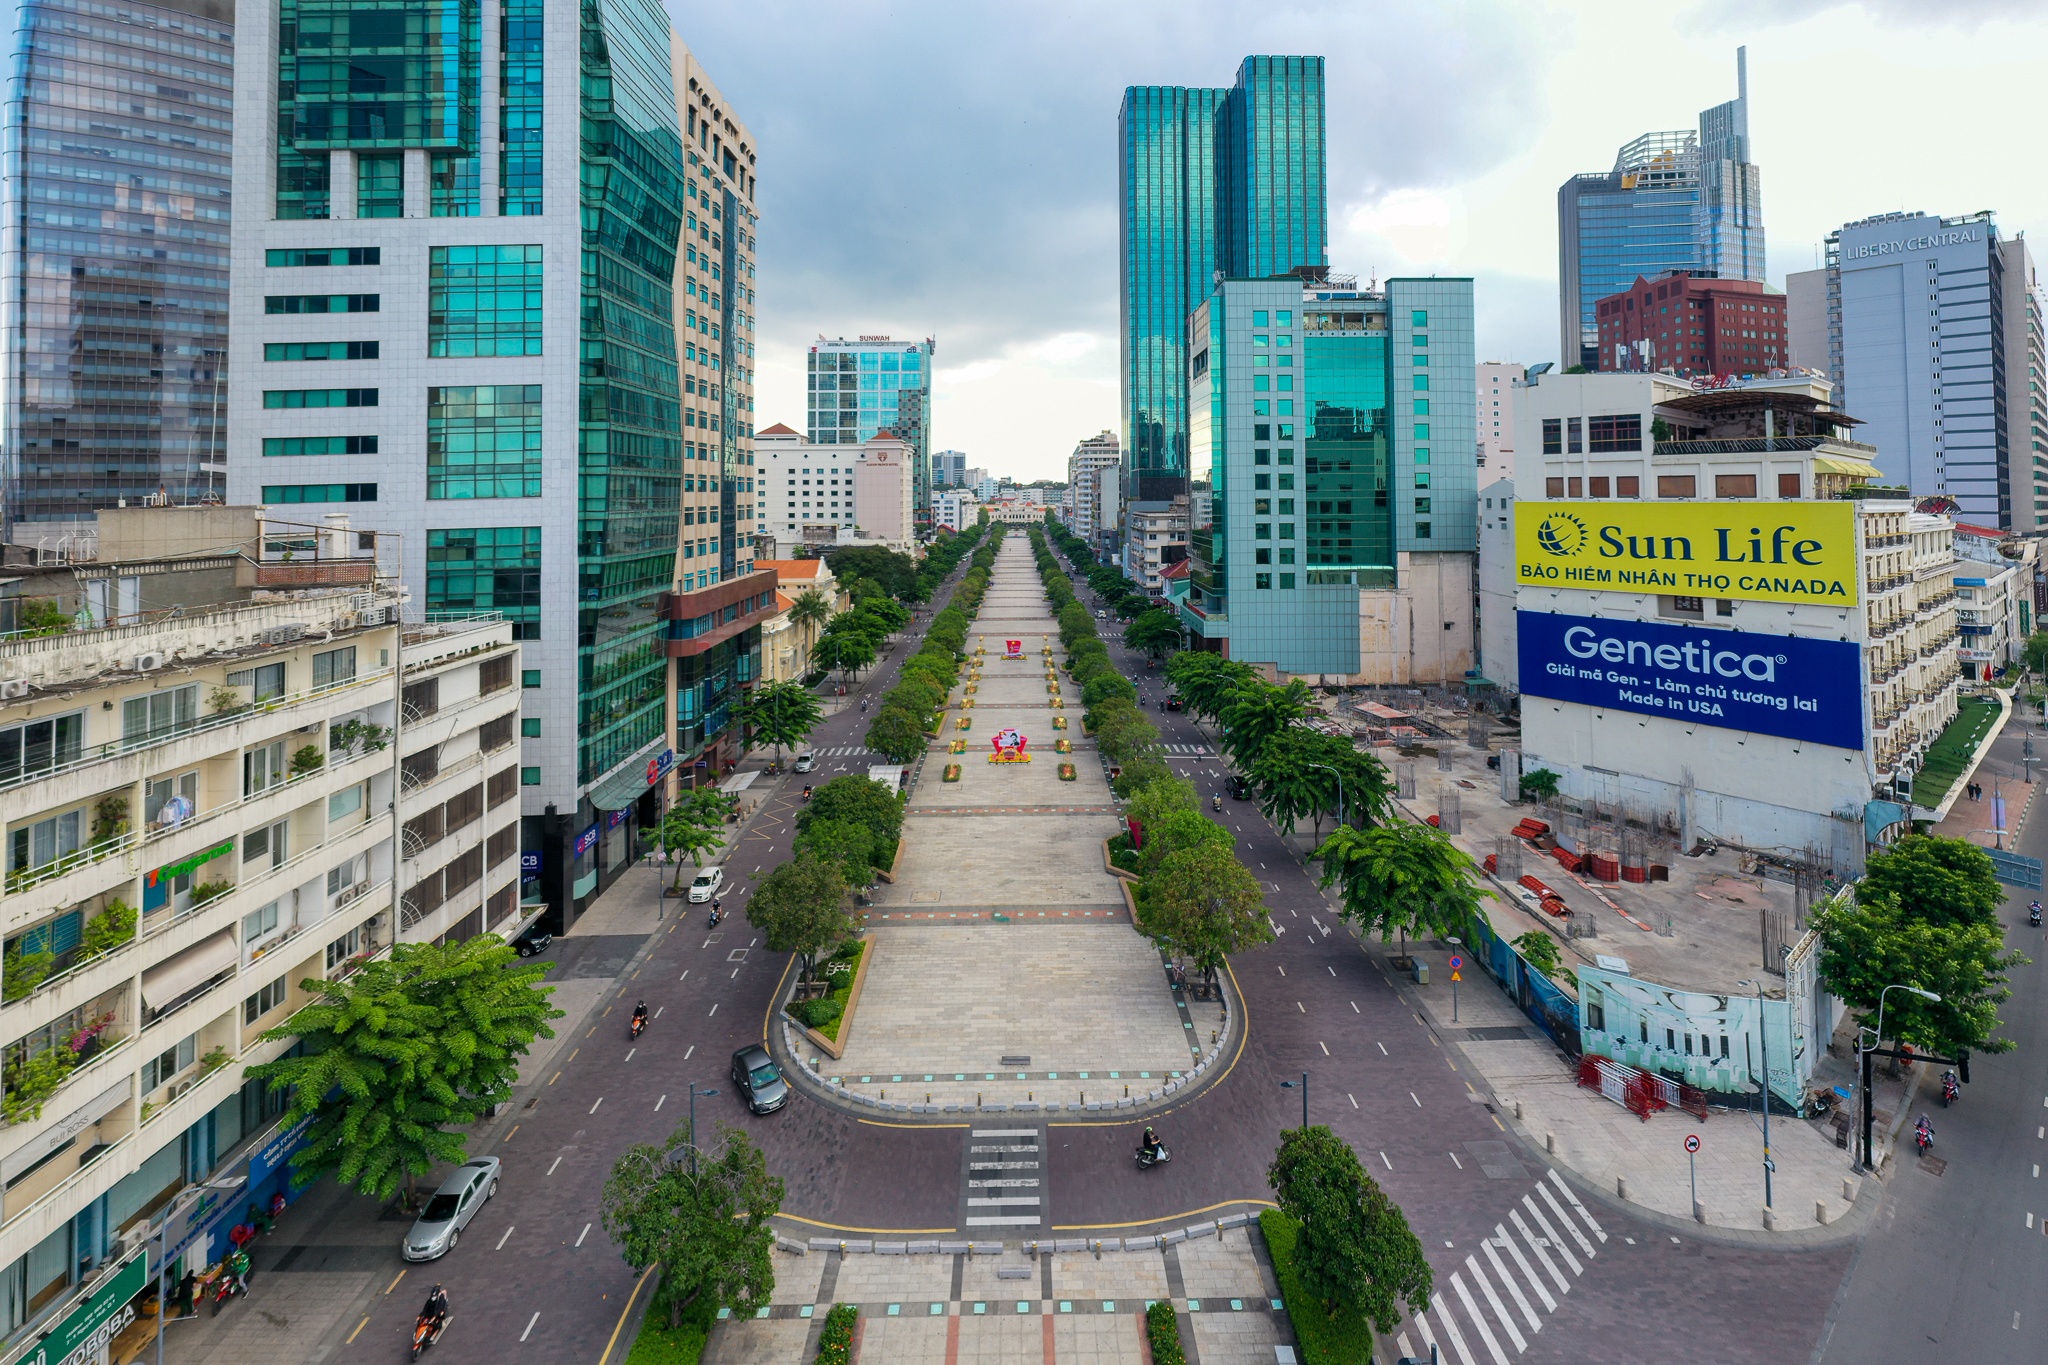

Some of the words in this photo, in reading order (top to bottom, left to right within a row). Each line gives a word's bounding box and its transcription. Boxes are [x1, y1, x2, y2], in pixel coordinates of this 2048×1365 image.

[1847, 239, 1905, 260] LIBERTY
[1906, 229, 1980, 251] CENTRAL
[1599, 525, 1695, 561] Sun
[1714, 526, 1823, 566] Life
[1521, 562, 1559, 579] BẢO
[1619, 569, 1676, 586] NHÂN
[1684, 573, 1731, 592] THỌ
[1738, 576, 1847, 596] CANADA
[1546, 662, 1575, 677] Giải
[1579, 669, 1602, 681] mã
[1606, 671, 1639, 686] Gen
[1656, 677, 1691, 694] Làm
[1695, 684, 1727, 699] chủ
[1732, 689, 1788, 711] tương
[1793, 696, 1817, 712] lai
[1619, 689, 1664, 707] Made
[1668, 697, 1684, 711] in
[1688, 700, 1724, 717] USA
[657, 748, 673, 772] SCB
[584, 829, 596, 845] SCB
[520, 855, 538, 866] CB
[523, 875, 536, 884] ATM
[67, 1114, 89, 1137] ROSS
